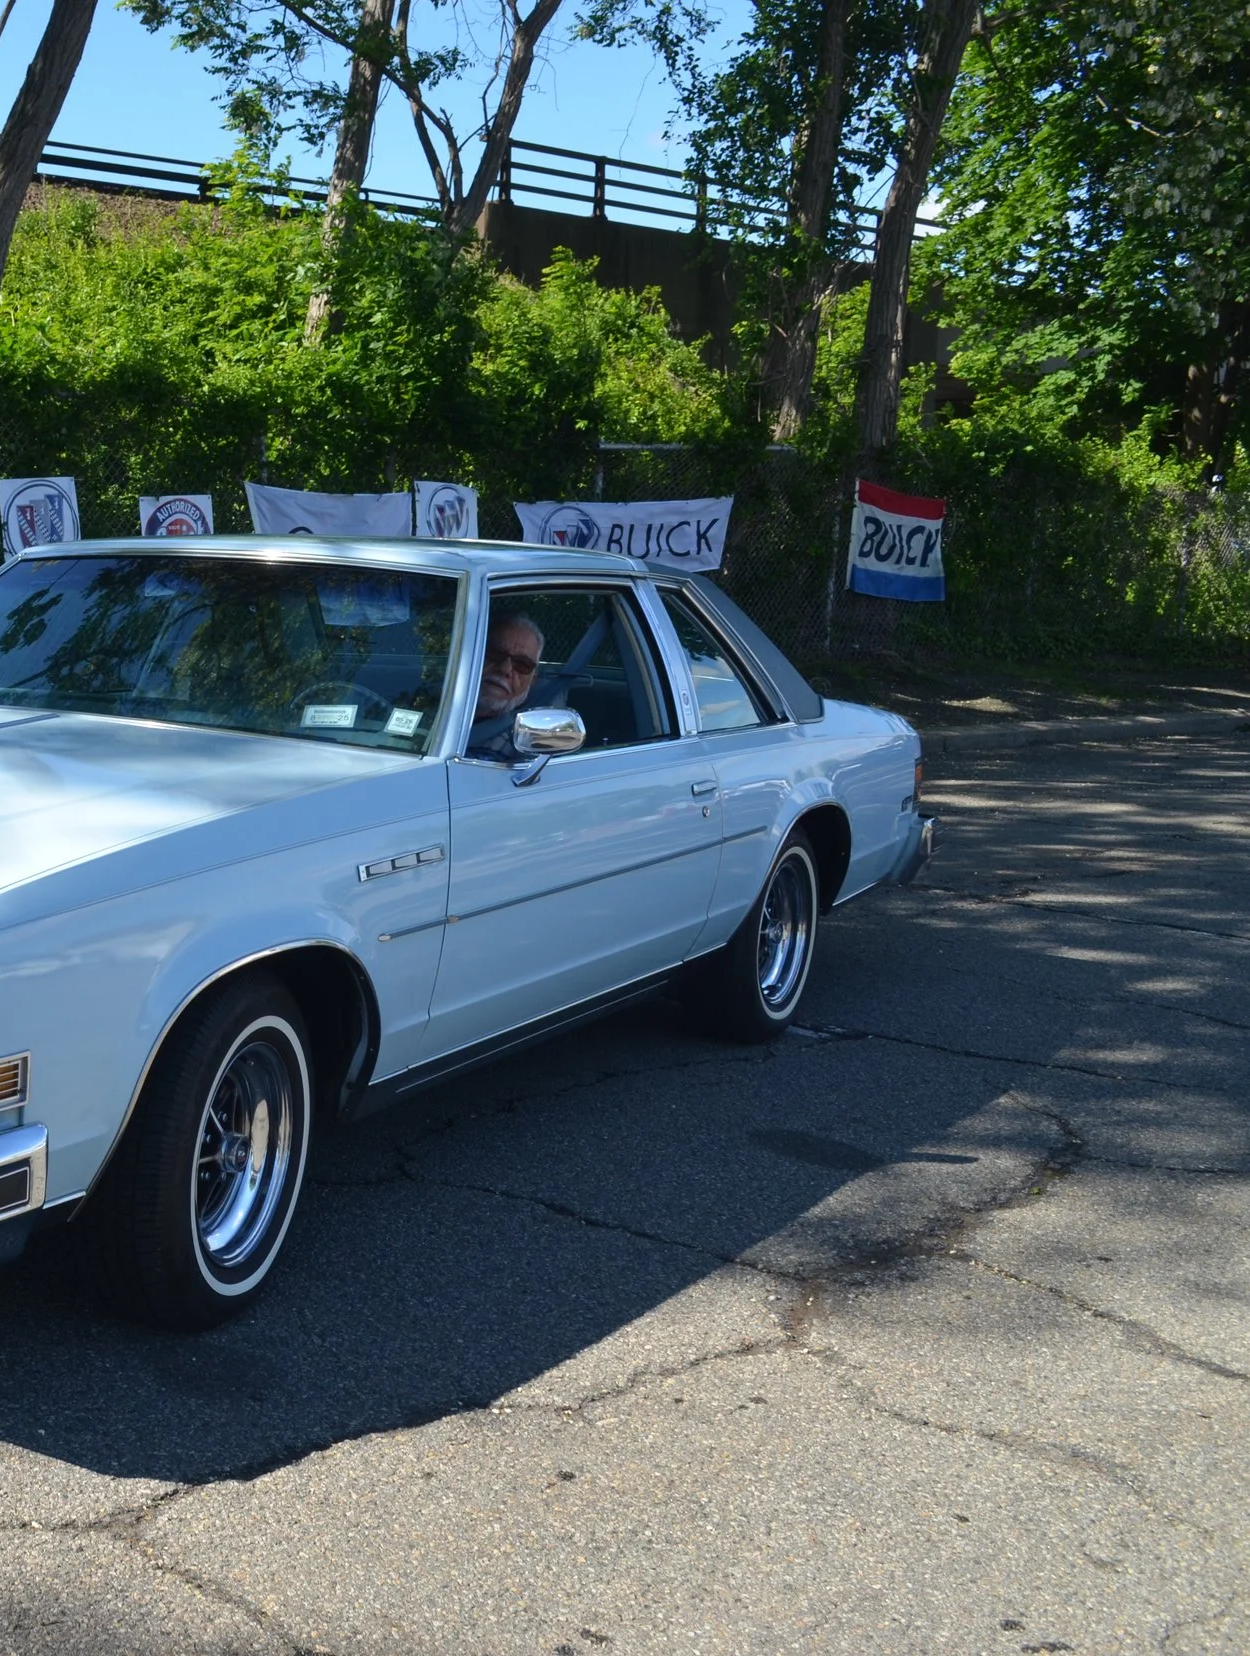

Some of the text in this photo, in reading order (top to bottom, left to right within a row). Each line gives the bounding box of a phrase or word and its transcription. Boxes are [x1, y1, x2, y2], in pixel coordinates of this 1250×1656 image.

[156, 501, 200, 522] AUTHORIZED
[607, 518, 719, 559] BUICK
[858, 515, 940, 567] BUICK
